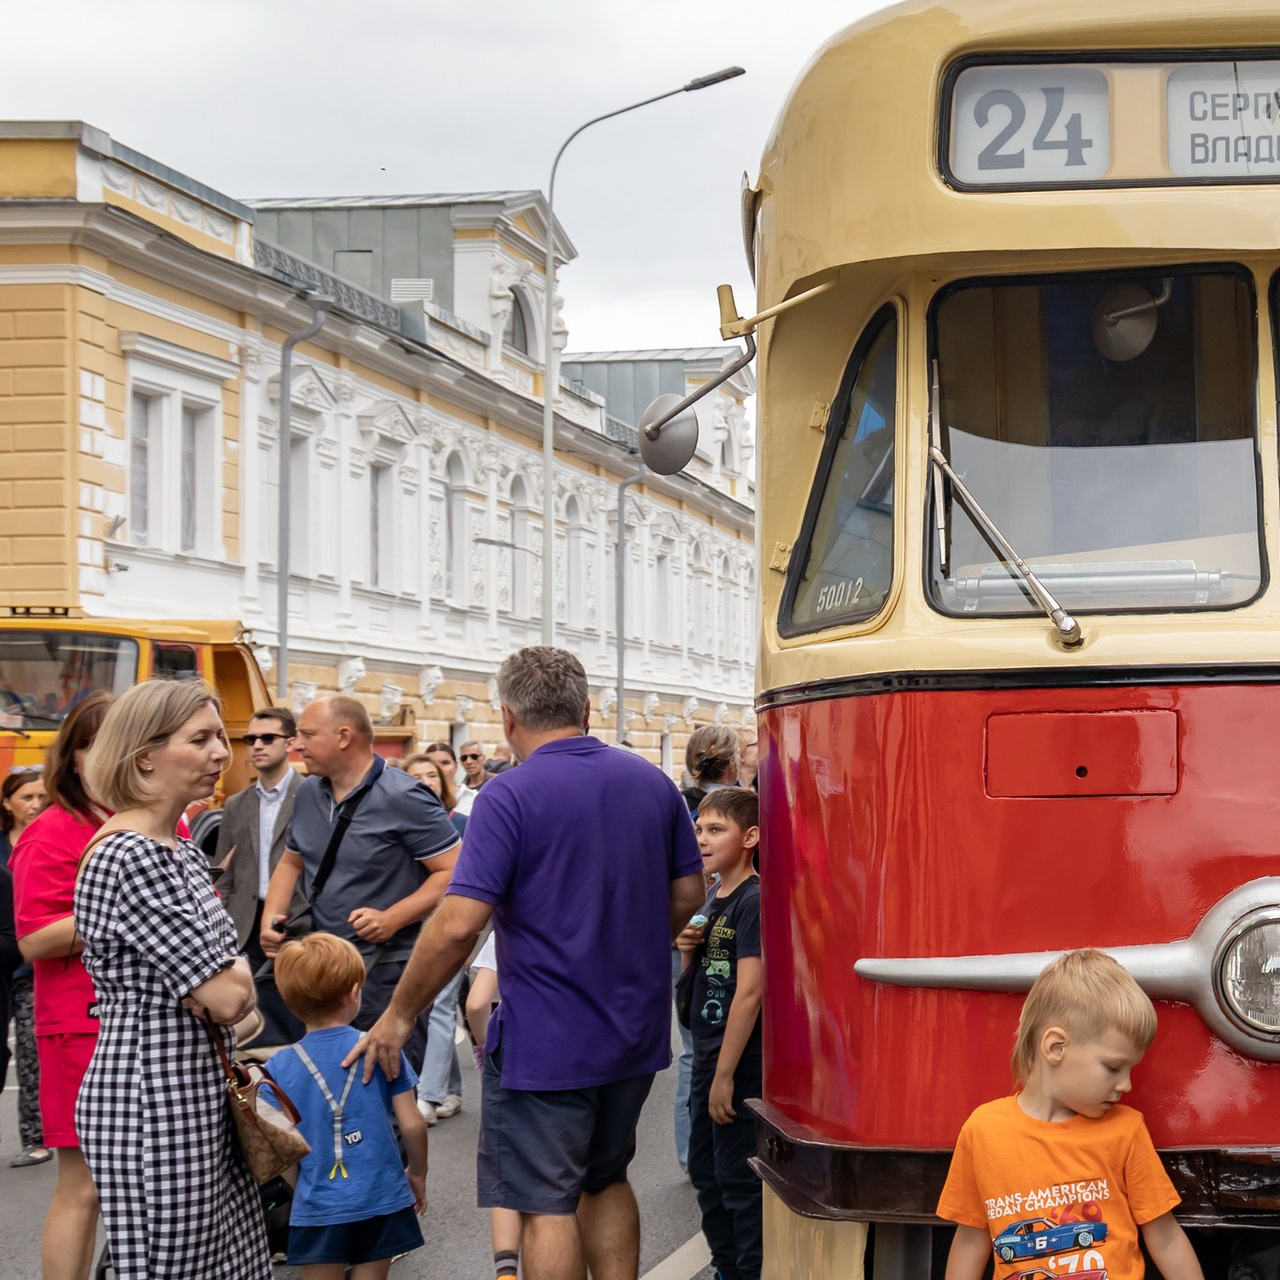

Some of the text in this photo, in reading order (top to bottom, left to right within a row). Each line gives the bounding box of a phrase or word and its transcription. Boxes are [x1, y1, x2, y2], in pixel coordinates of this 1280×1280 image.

[972, 86, 1094, 171] 24
[816, 576, 864, 613] 50012
[984, 1179, 1108, 1210] TRANS-AMERICAN
[1025, 1188, 1111, 1213] CHAMPIONS
[1035, 1236, 1048, 1250] 6
